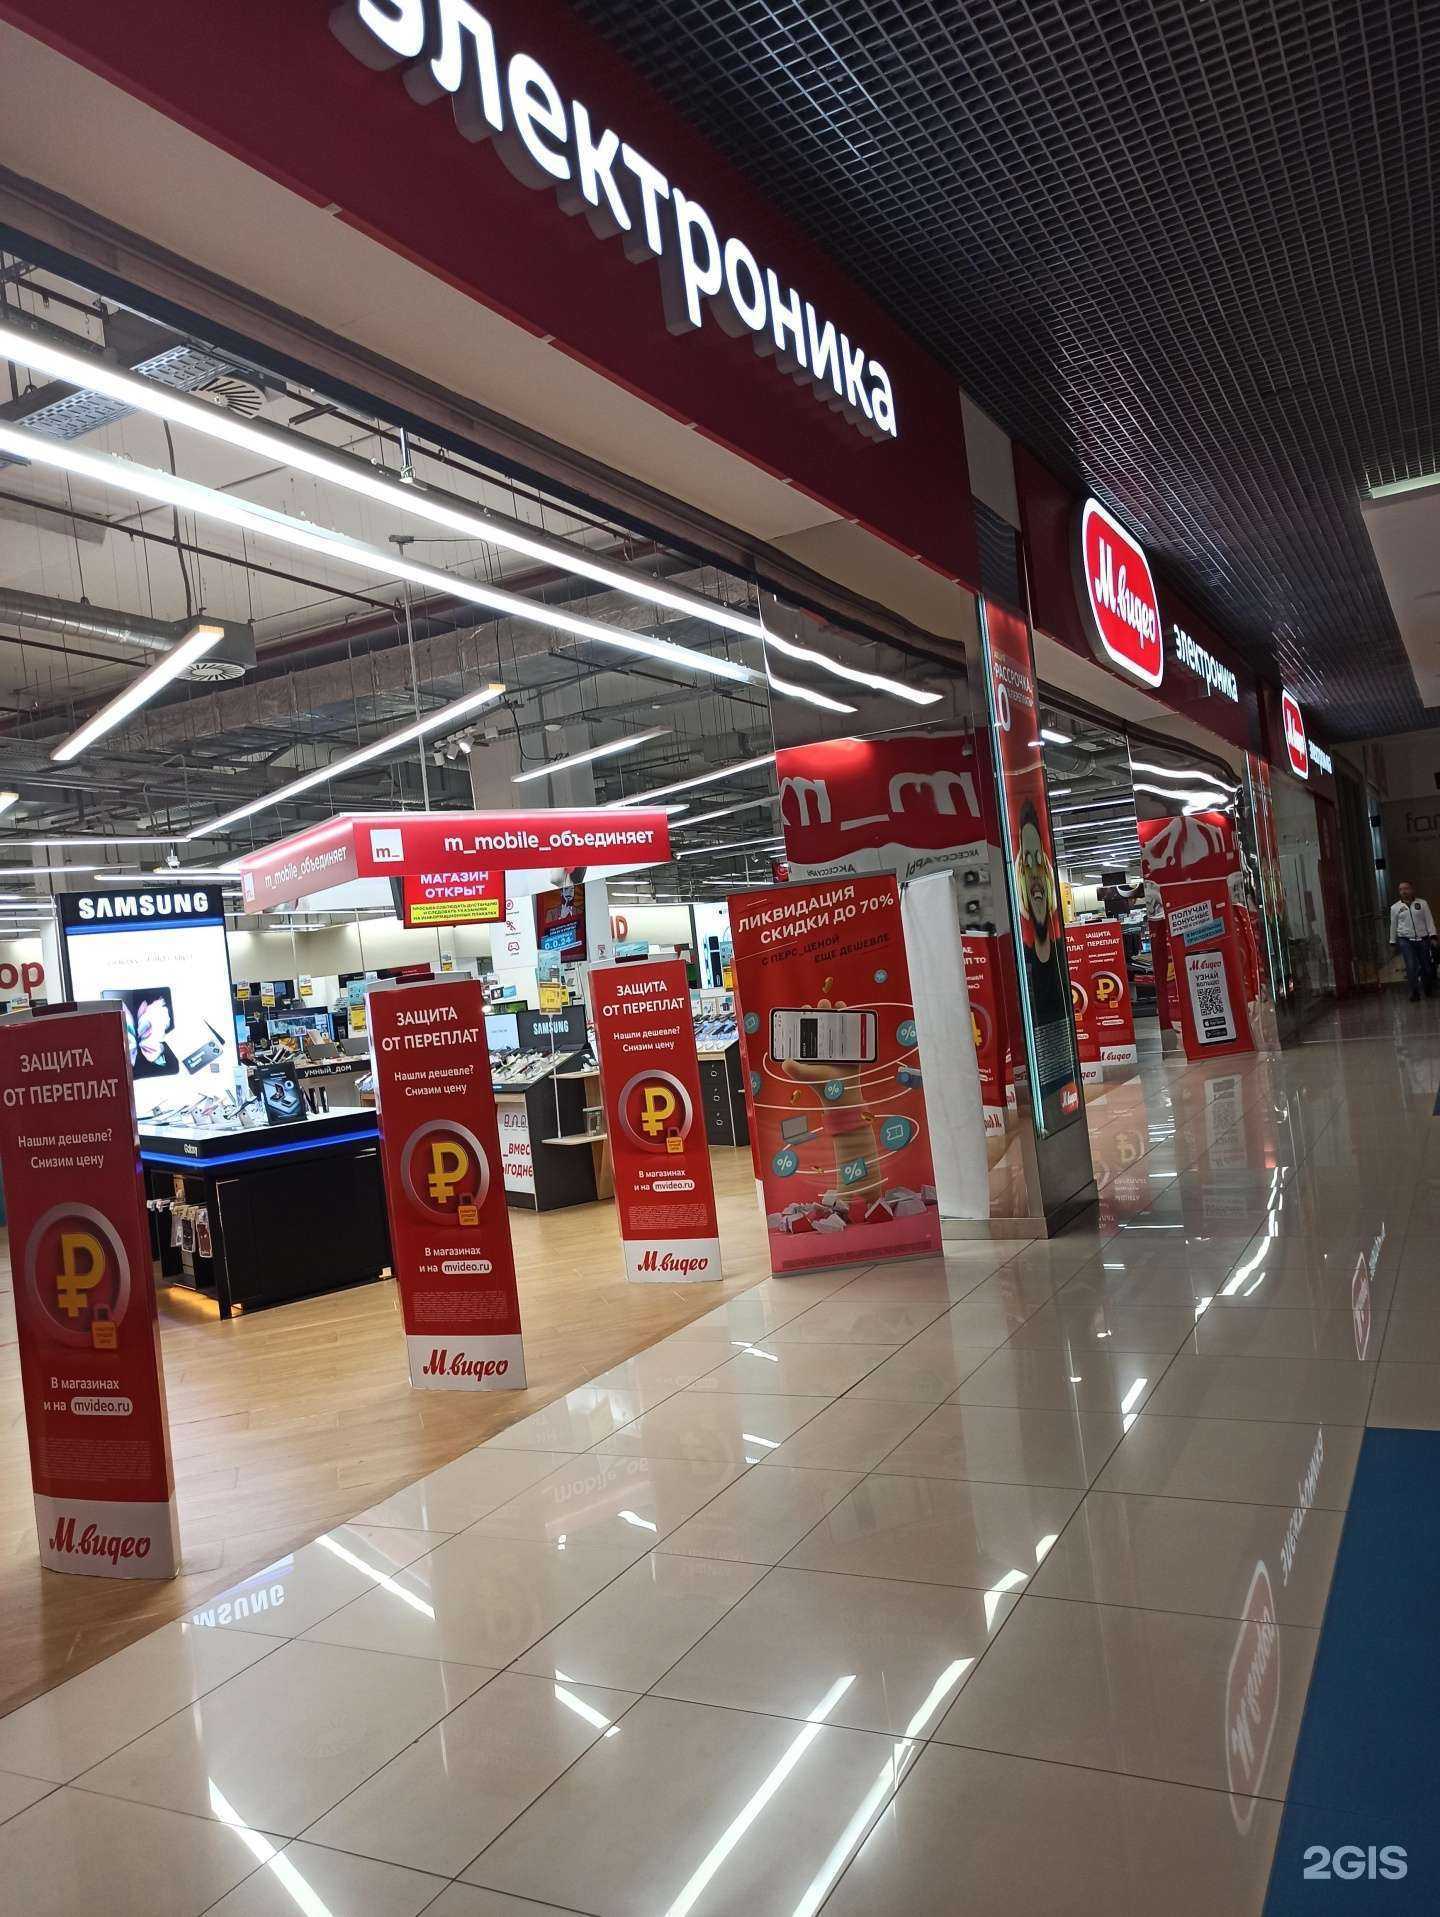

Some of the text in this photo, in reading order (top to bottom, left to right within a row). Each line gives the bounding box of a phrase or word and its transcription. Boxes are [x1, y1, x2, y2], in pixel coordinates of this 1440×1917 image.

[1173, 623, 1239, 703] электроника
[444, 830, 654, 855] m_mobile_объединяет
[264, 846, 347, 889] m_mobile_объединяет
[420, 870, 489, 885] МАГАЗИН
[425, 885, 486, 898] ОТКРЫТ
[78, 892, 209, 919] SAMSUNG
[738, 885, 855, 932] ЛИКВИДАЦИЯ
[760, 893, 894, 943] СКИДКИ ДО 70%
[616, 980, 667, 996] ЗАЩИТА
[396, 1006, 458, 1026] ЗАЩИТА
[603, 997, 685, 1017] ОТ ПЕРЕПЛАТ
[533, 1019, 569, 1035] SAMSUNG
[613, 1026, 680, 1040] Нашли дешевле?
[382, 1028, 479, 1051] ОТ ПЕРЕПЛАТ
[622, 1041, 674, 1052] Снизим цену
[20, 1047, 94, 1073] ЗАЩИТА
[394, 1064, 474, 1081] Нашли дешевле?
[3, 1078, 119, 1107] ОТ ПЕРЕПЛАТ
[405, 1083, 467, 1097] Снизим цену
[18, 1128, 112, 1148] Нашли дешевле?
[31, 1154, 104, 1169] Снизим цену
[638, 1170, 686, 1178] В магазинах
[654, 1181, 693, 1190] mvideo.ru
[424, 1247, 481, 1258] В магазинах
[419, 1261, 490, 1273] и на mvideo.ru
[637, 1250, 709, 1275] М.видео
[423, 1349, 509, 1382] М.видео
[51, 1377, 120, 1391] В магазинах
[43, 1399, 131, 1413] и на mvideo.ru
[50, 1517, 151, 1565] М.видео
